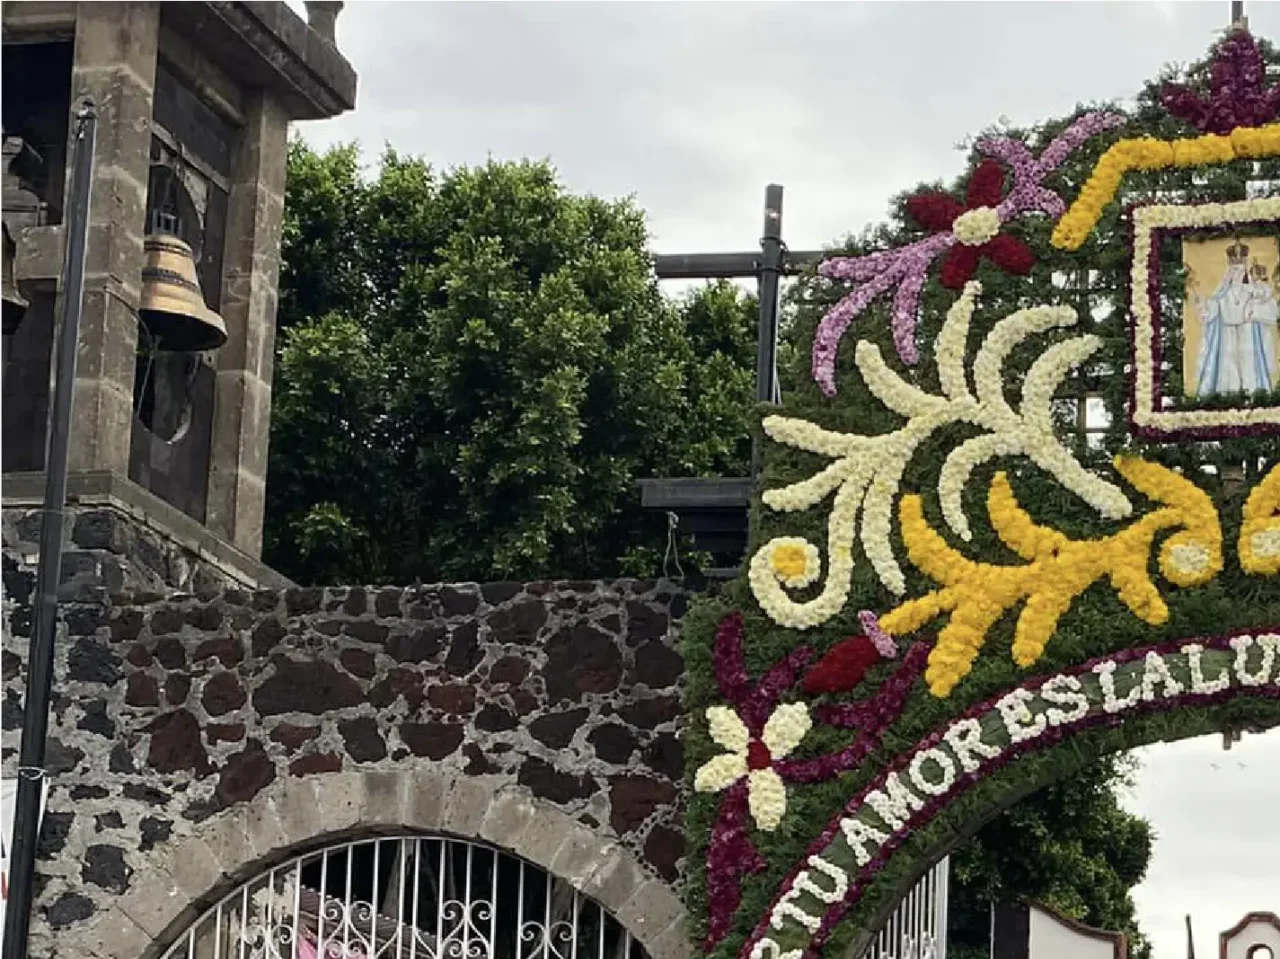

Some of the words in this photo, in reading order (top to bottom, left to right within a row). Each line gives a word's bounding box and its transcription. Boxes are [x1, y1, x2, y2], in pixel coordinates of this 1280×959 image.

[770, 854, 849, 934] TU
[839, 717, 1001, 866] AMOR
[1000, 674, 1090, 744] ES
[1091, 650, 1184, 714] LA
